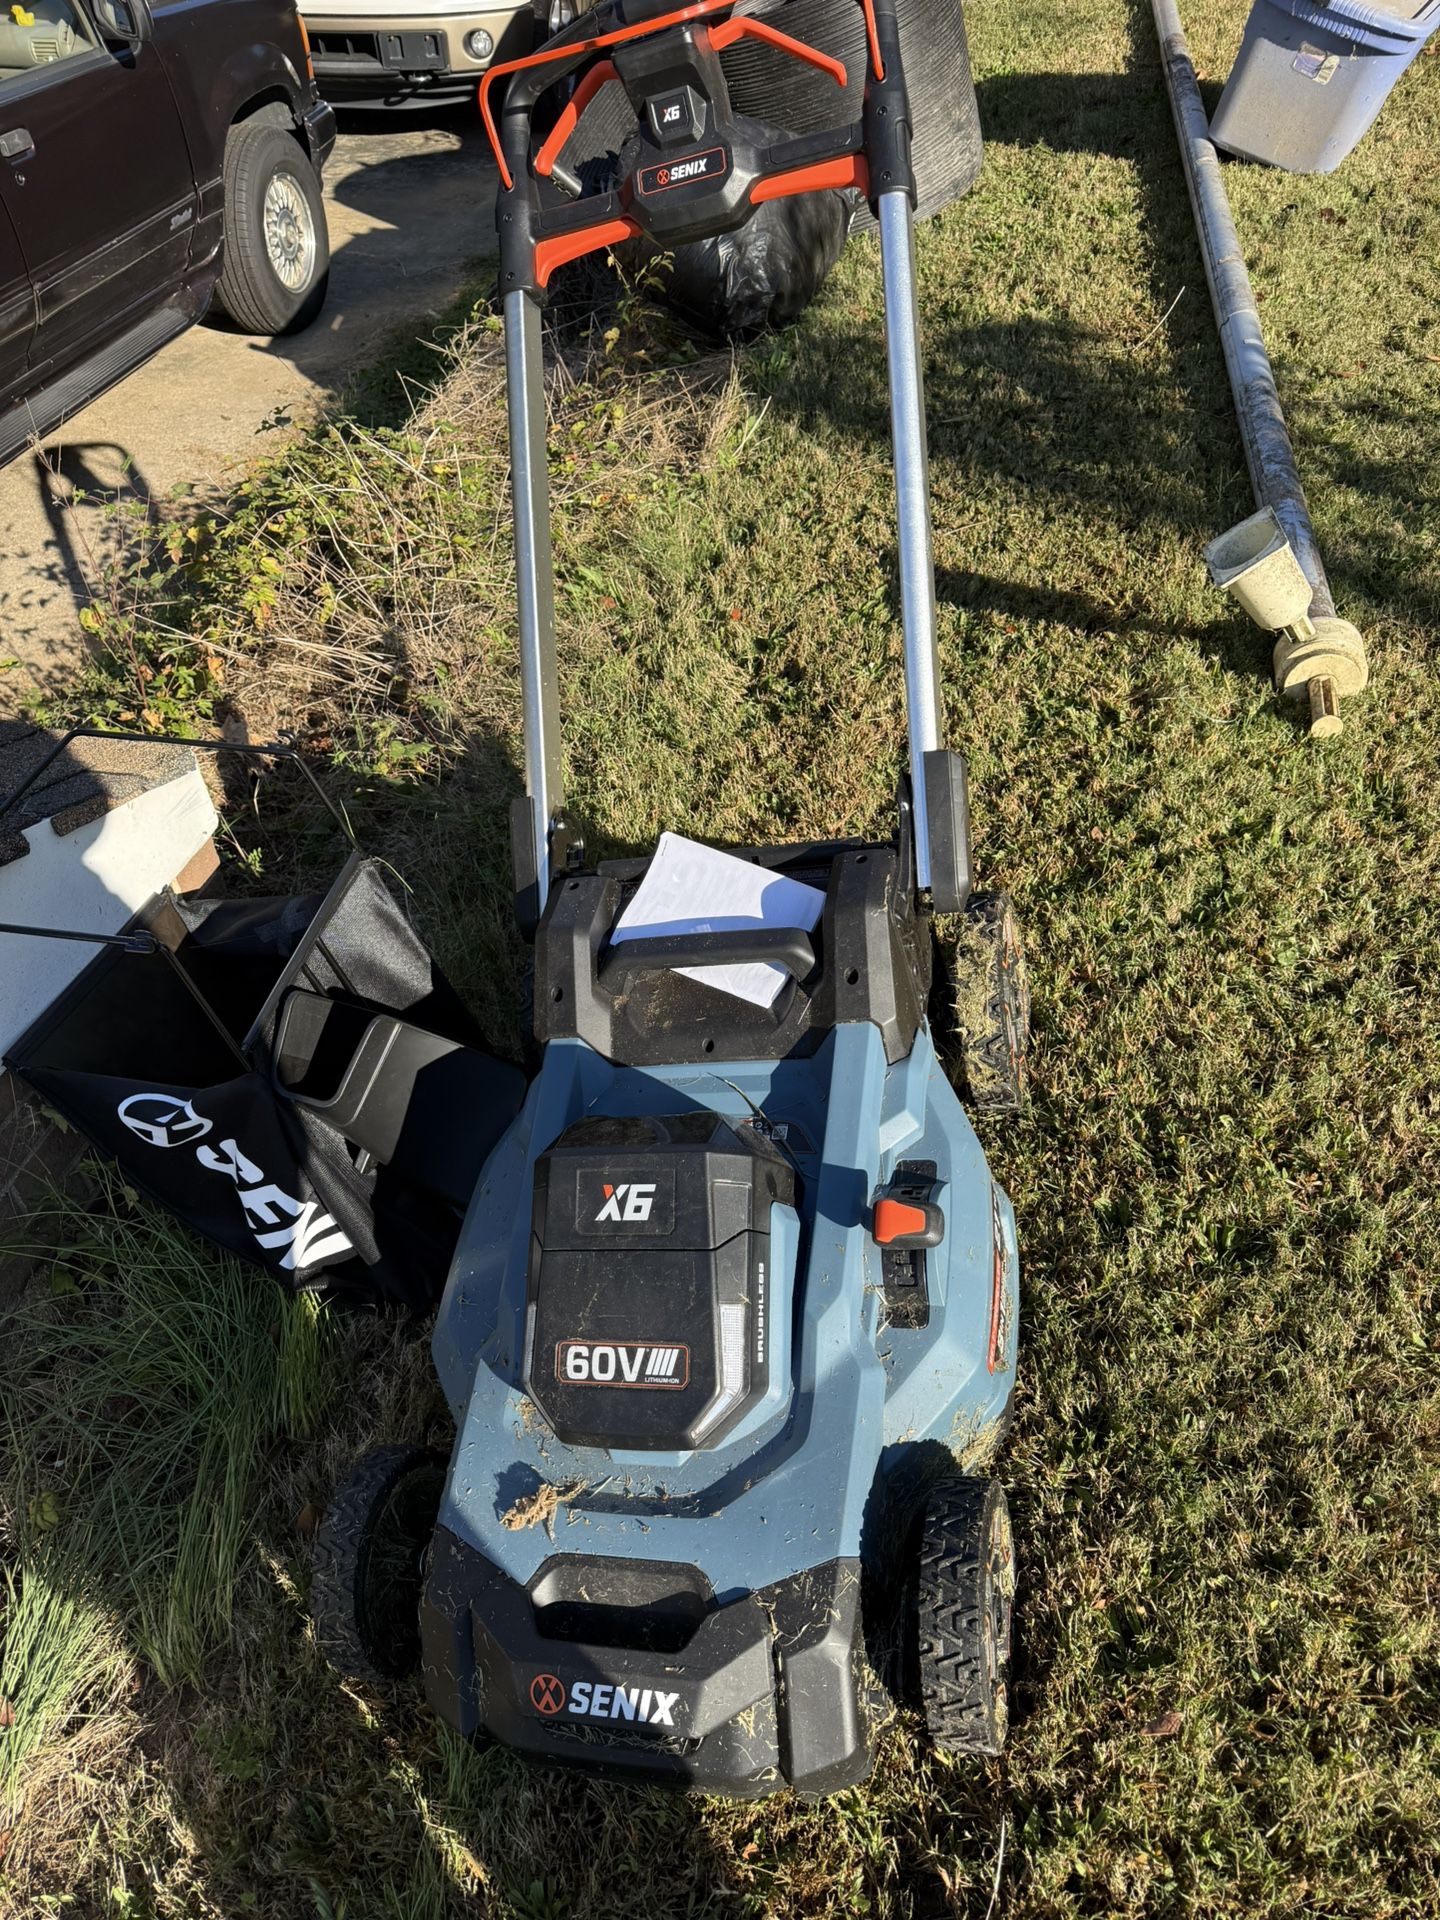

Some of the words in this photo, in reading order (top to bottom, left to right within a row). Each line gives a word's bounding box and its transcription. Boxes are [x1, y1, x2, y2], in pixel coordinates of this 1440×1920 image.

[663, 105, 680, 122] X6
[671, 158, 707, 181] SENIX
[197, 1139, 353, 1270] SENI
[595, 1184, 656, 1221] X6
[757, 1262, 765, 1363] BRUSHLESS
[566, 1345, 645, 1382] 60V
[569, 1681, 680, 1726] SENIX
